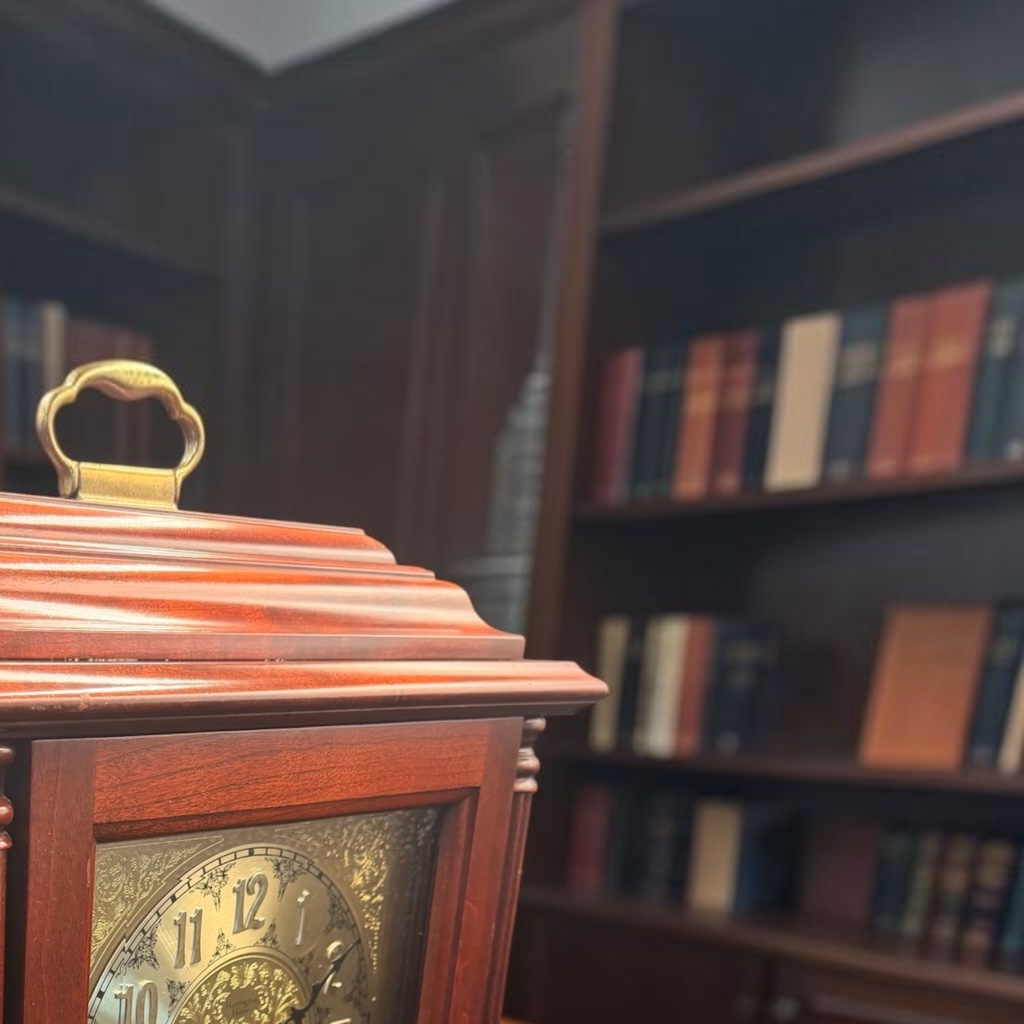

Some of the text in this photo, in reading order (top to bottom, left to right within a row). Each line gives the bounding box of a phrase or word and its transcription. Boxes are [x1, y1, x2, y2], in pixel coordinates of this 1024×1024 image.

[232, 872, 269, 935] 12
[296, 890, 310, 945] 1
[173, 909, 203, 970] 11
